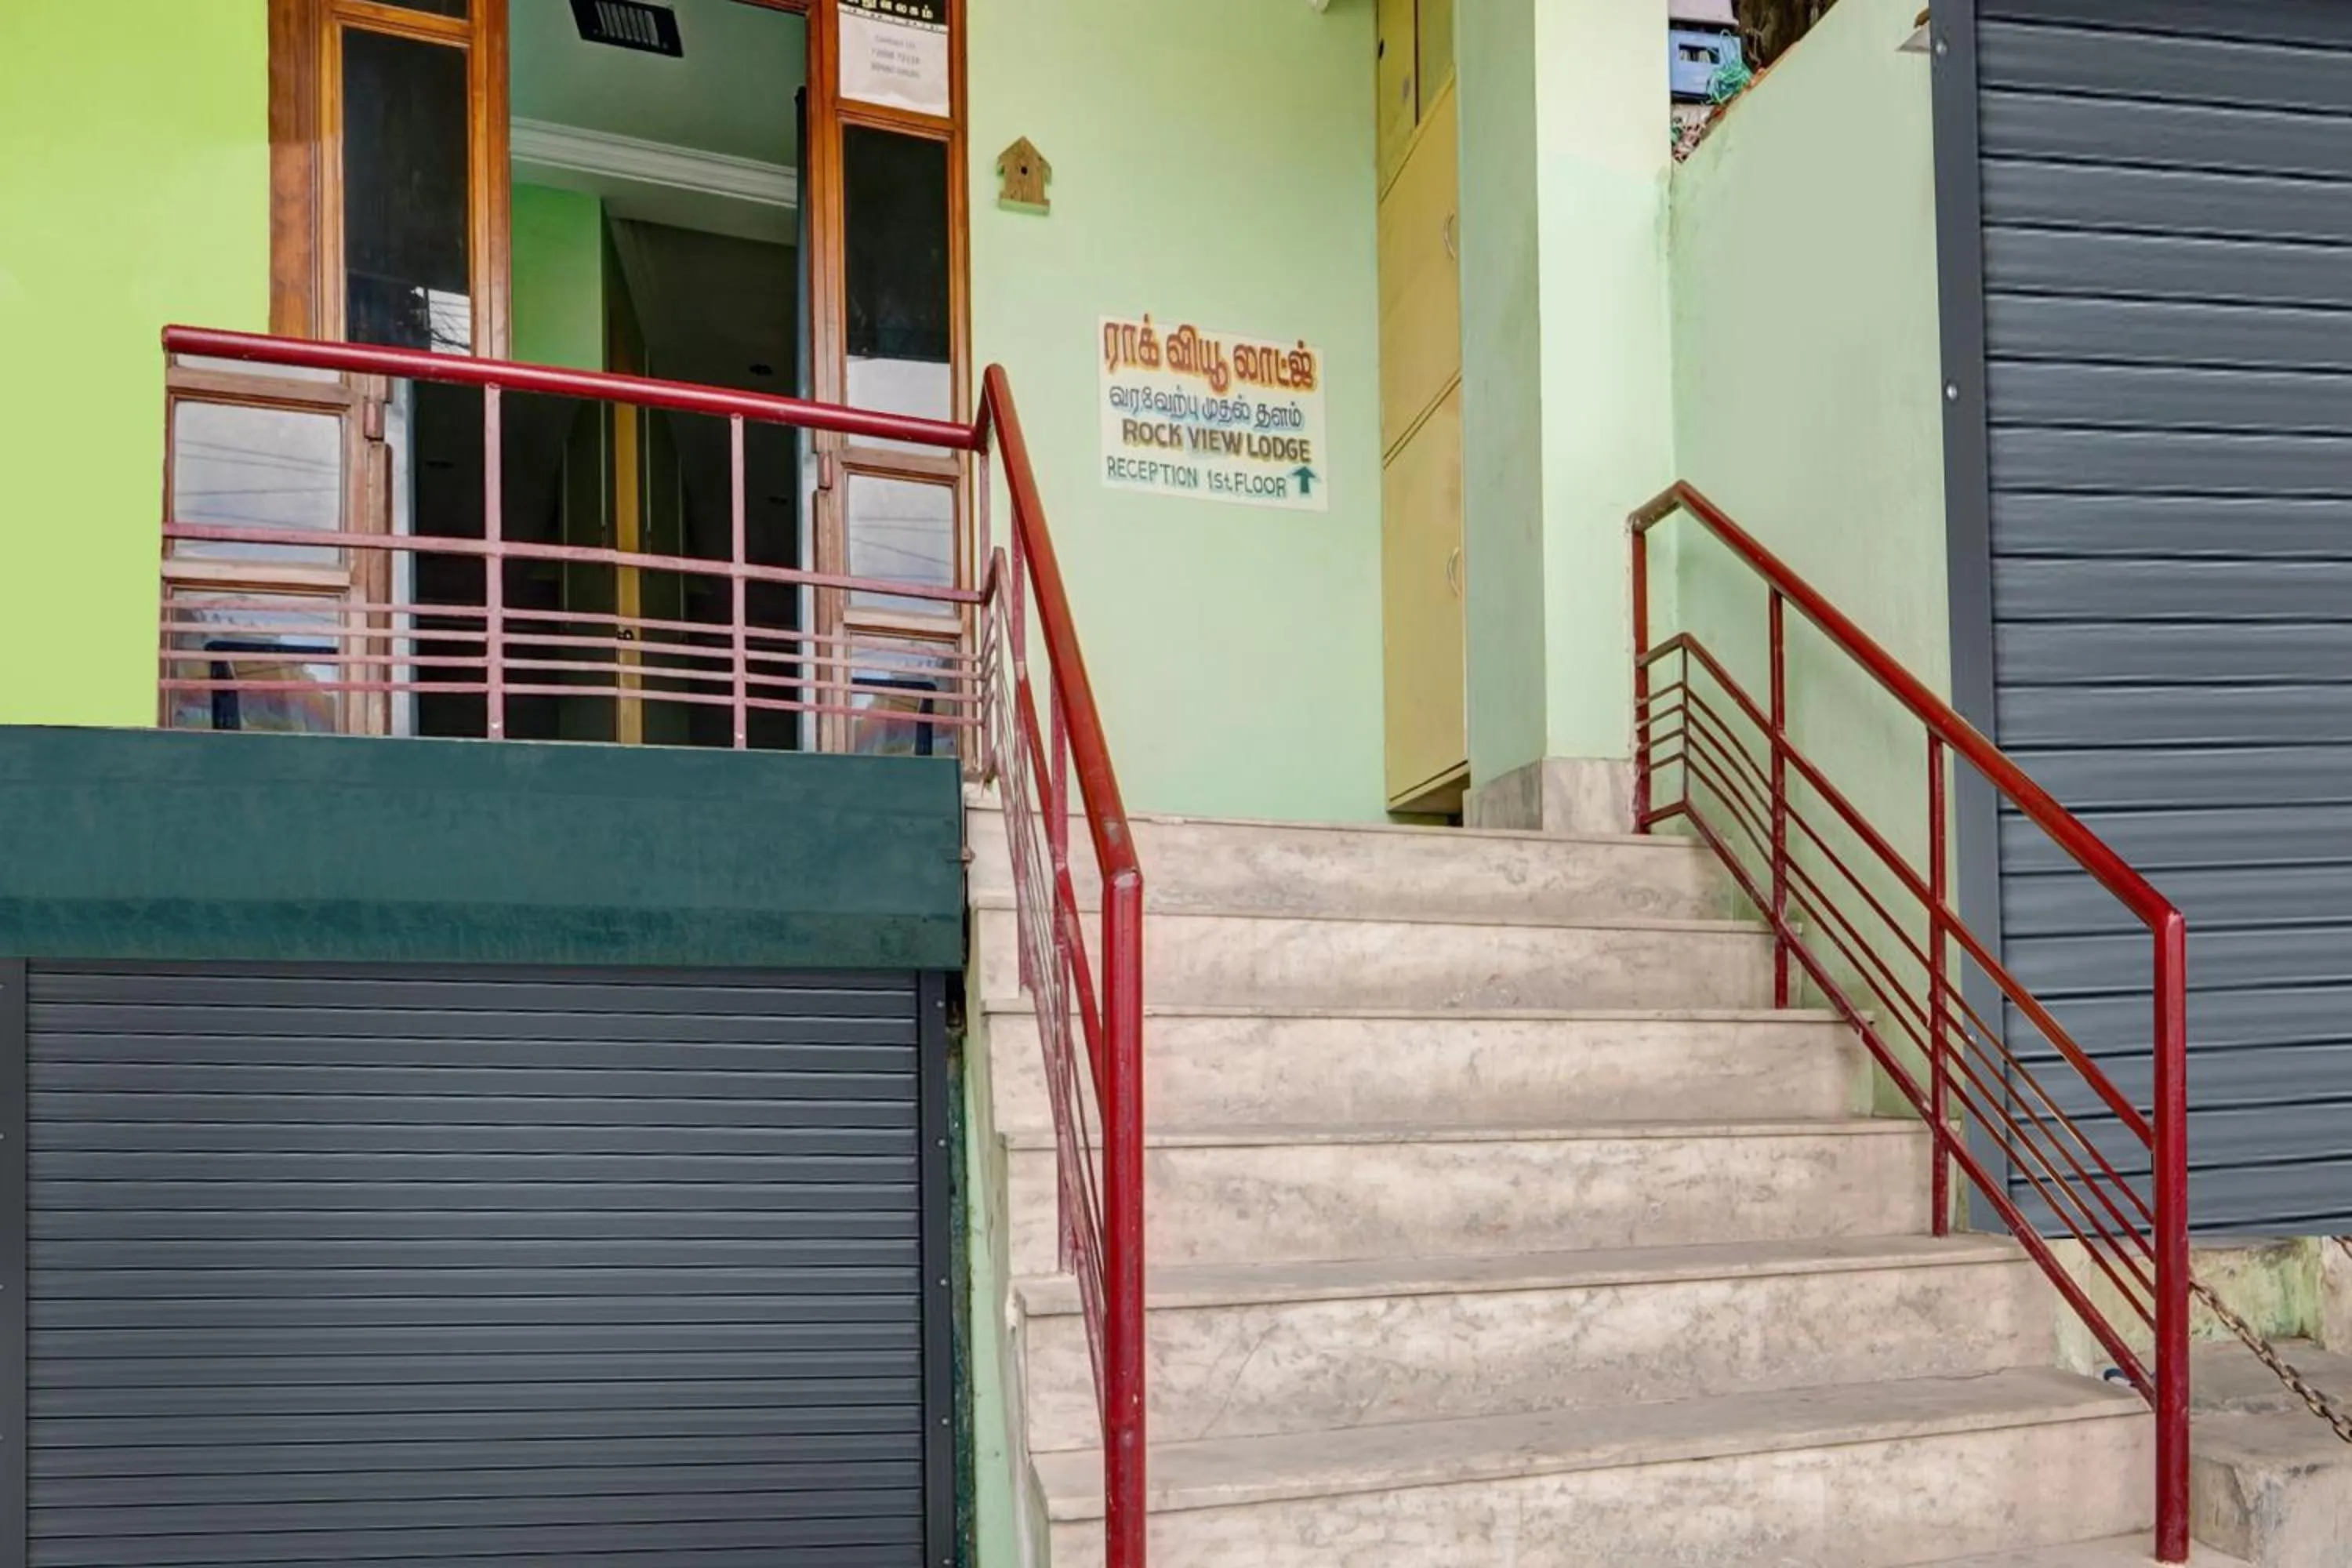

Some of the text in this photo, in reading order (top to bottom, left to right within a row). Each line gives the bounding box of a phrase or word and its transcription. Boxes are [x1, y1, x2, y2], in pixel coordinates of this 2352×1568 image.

[1104, 313, 1315, 394] ராக் வியூ லாட்ஜ்
[1109, 385, 1302, 428] வரவேற்பு முதல் தளம்
[1122, 419, 1312, 464] ROCK VIEW LODGE
[1106, 455, 1198, 488] RECEPTION
